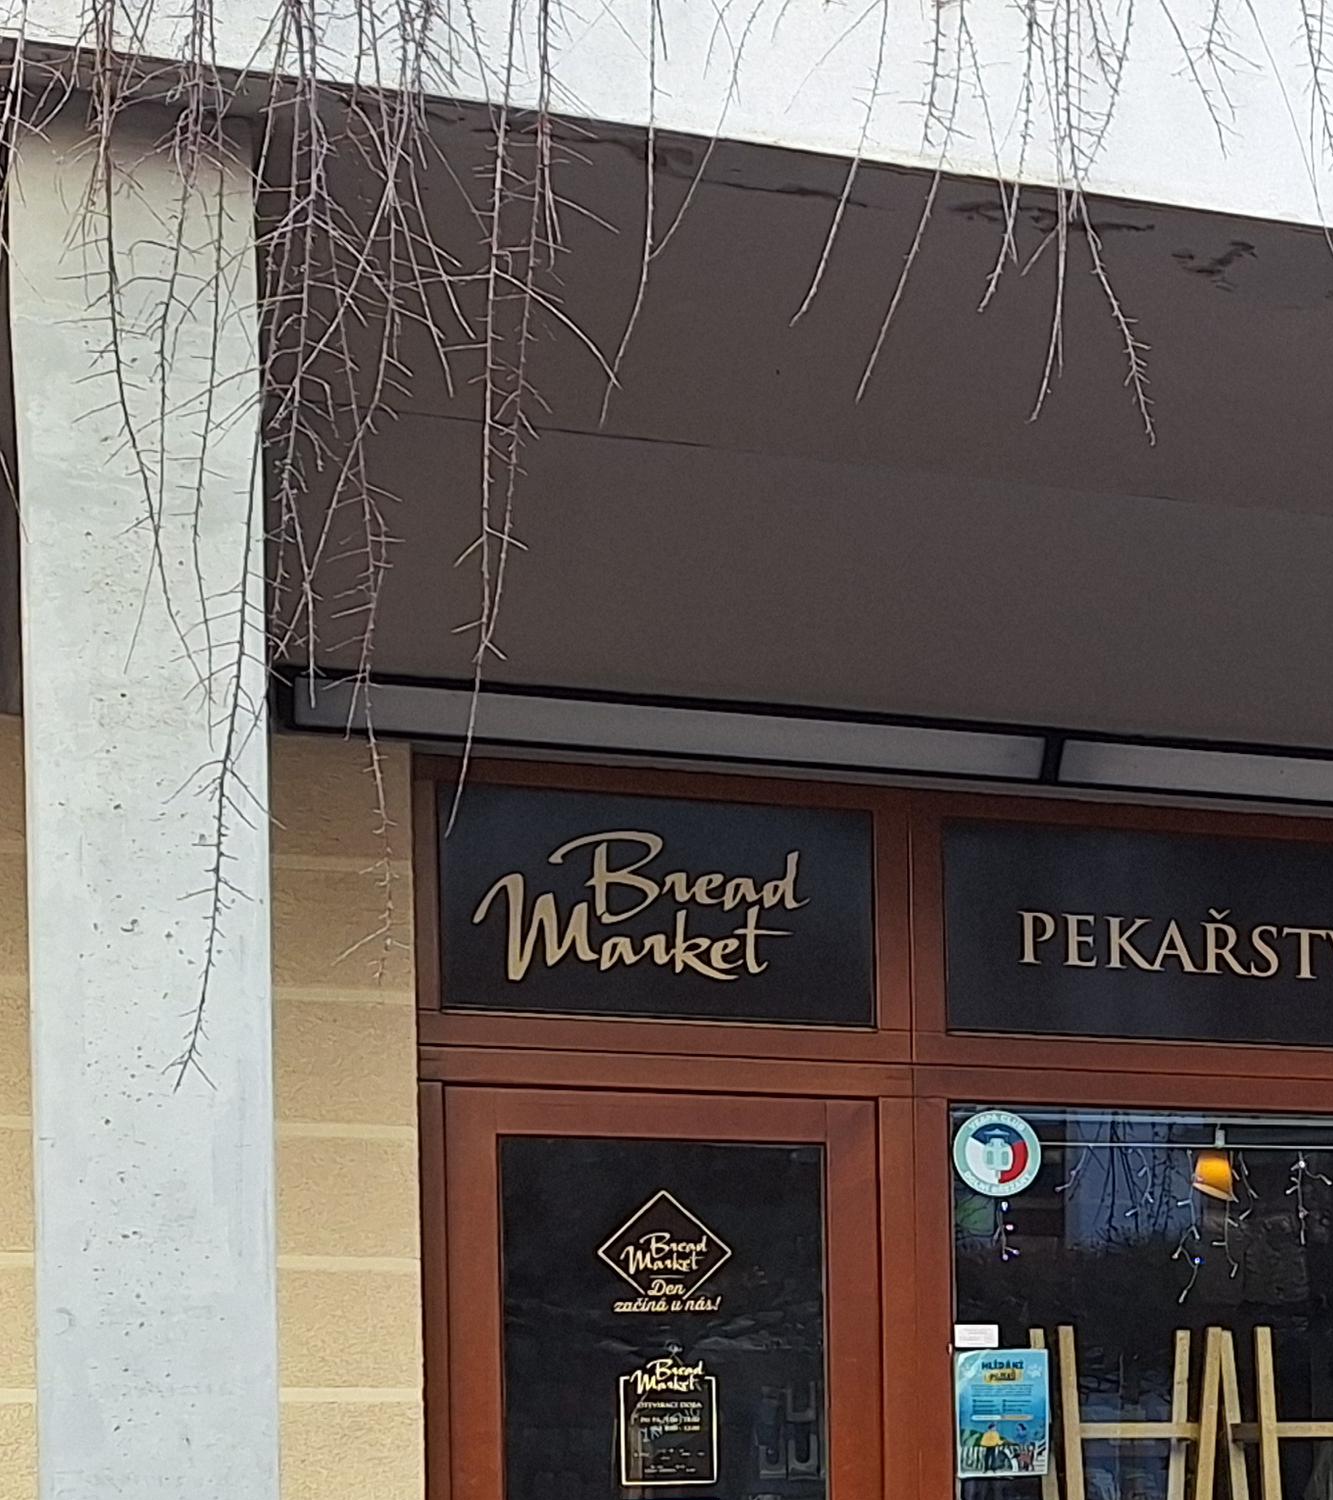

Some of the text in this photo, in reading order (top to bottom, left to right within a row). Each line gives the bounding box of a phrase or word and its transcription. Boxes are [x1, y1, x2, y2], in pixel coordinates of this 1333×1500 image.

[548, 830, 810, 923] Bread
[472, 872, 795, 981] Market
[639, 1232, 708, 1258] Bread
[619, 1246, 704, 1275] Market
[647, 1279, 687, 1296] Den
[613, 1296, 722, 1312] začíná u nás!
[646, 1358, 705, 1380] Bread
[629, 1370, 700, 1394] Market
